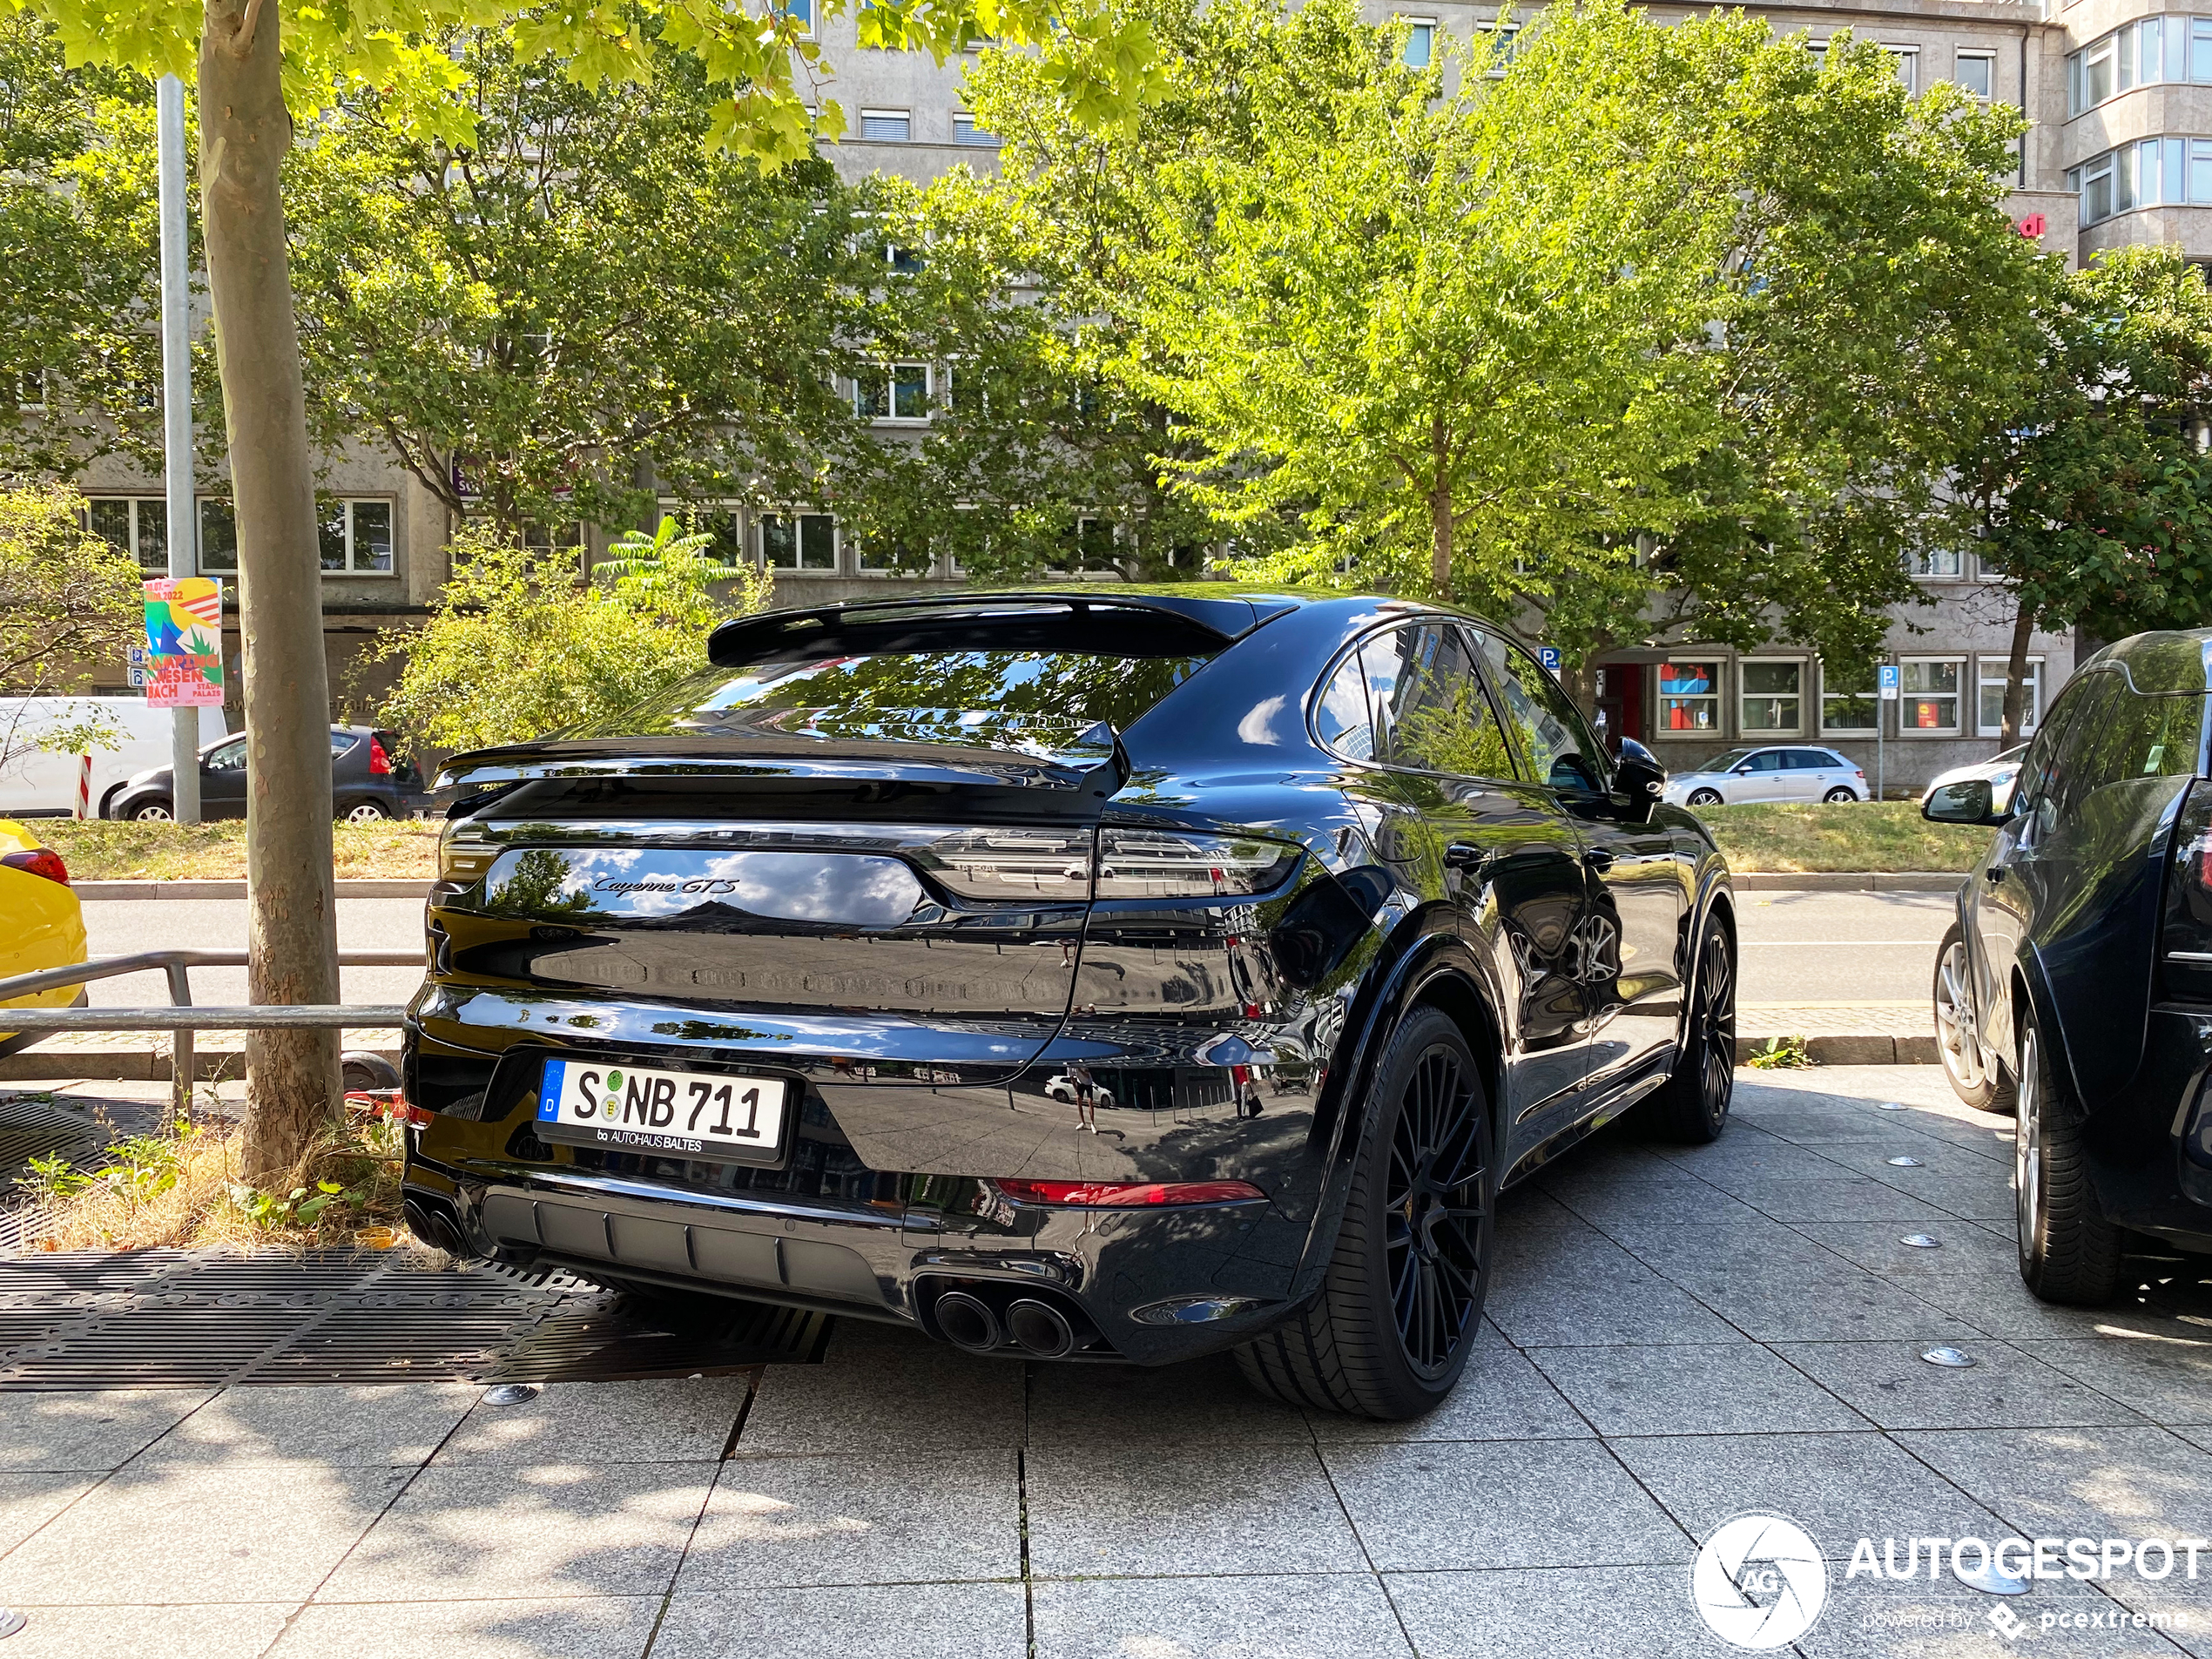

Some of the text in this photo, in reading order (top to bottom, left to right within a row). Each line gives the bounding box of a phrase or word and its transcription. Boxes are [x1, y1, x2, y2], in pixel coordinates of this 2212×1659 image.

[1884, 669, 1893, 685] P
[147, 684, 179, 699] BACH
[592, 877, 740, 898] Cayenne GTS
[545, 1098, 554, 1112] D
[574, 1071, 600, 1119] S
[623, 1076, 677, 1128] NB
[687, 1082, 760, 1139] 711
[610, 1130, 664, 1148] AUTOHAUS
[663, 1136, 703, 1152] BALTES
